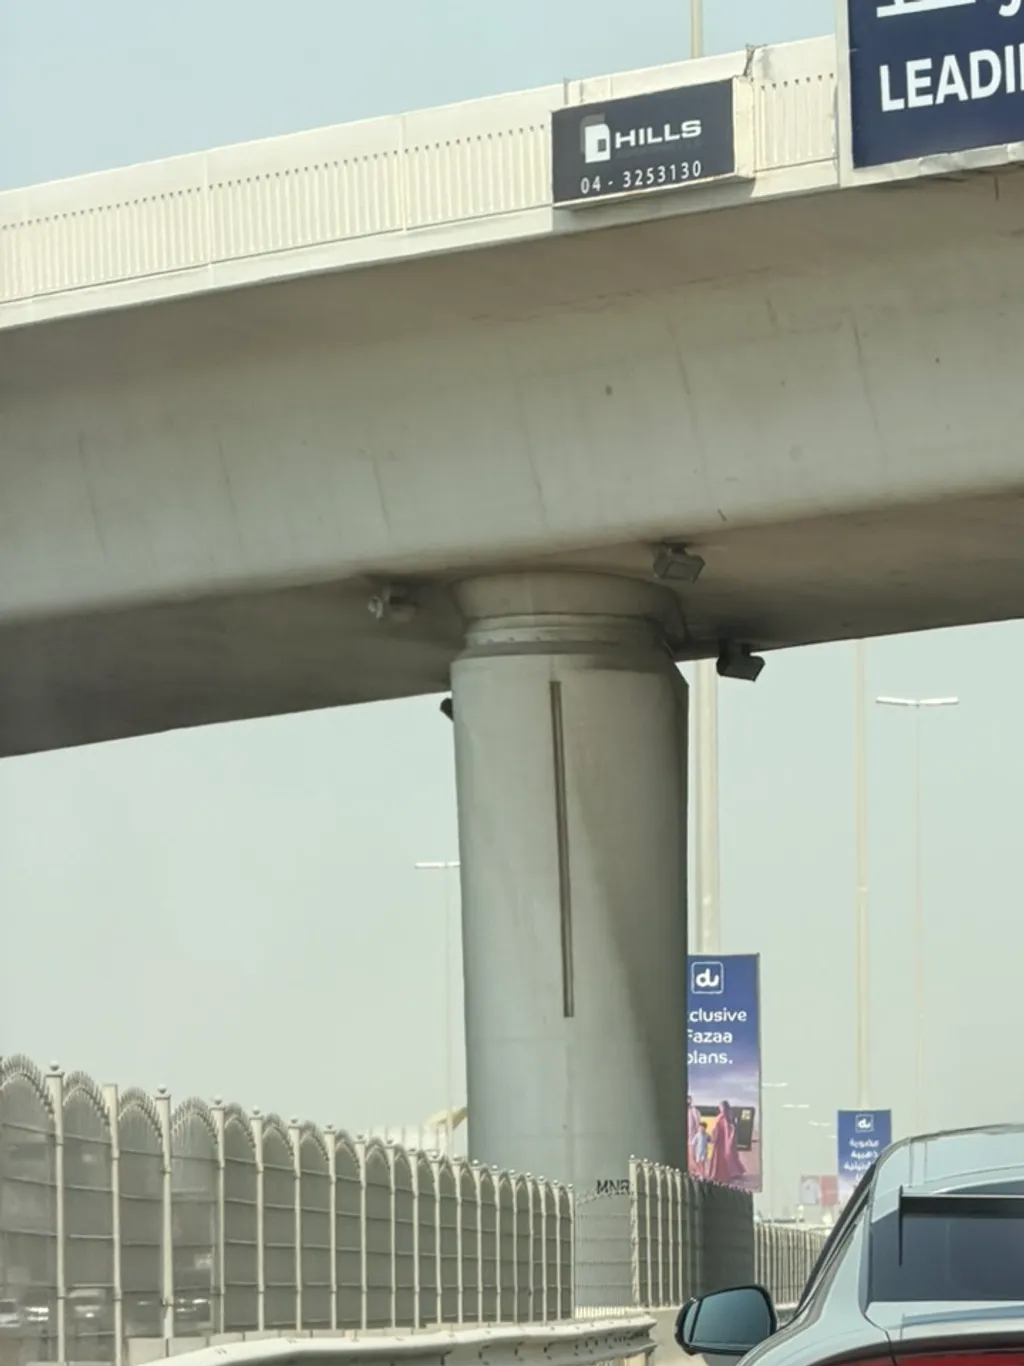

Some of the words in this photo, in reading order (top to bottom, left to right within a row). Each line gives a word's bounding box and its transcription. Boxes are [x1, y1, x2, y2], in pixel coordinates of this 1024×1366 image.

[614, 119, 702, 149] HILLS
[580, 175, 602, 194] 04
[622, 159, 702, 188] 3253130
[695, 967, 720, 987] du
[688, 1006, 748, 1022] clusive
